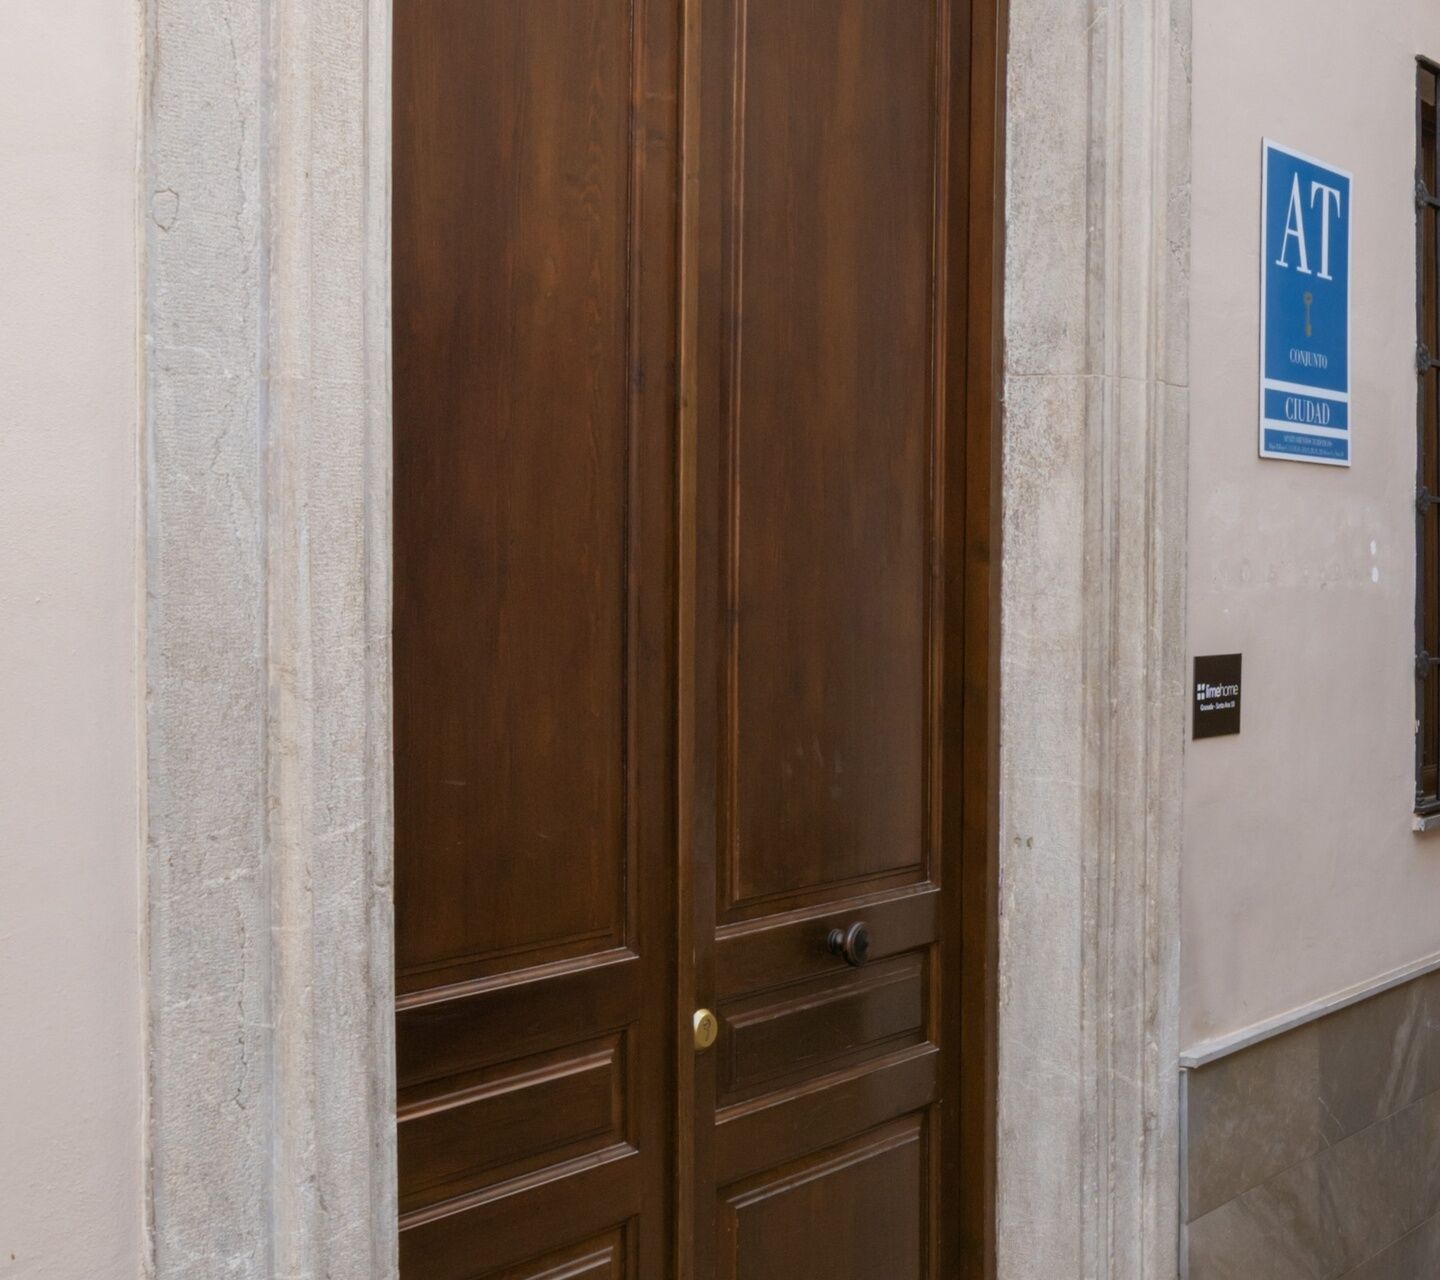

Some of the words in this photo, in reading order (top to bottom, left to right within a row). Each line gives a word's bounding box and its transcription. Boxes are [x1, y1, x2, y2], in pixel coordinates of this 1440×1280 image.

[1275, 171, 1340, 281] AT
[1289, 347, 1328, 369] CONJUNTO
[1285, 396, 1330, 425] CIUDAD
